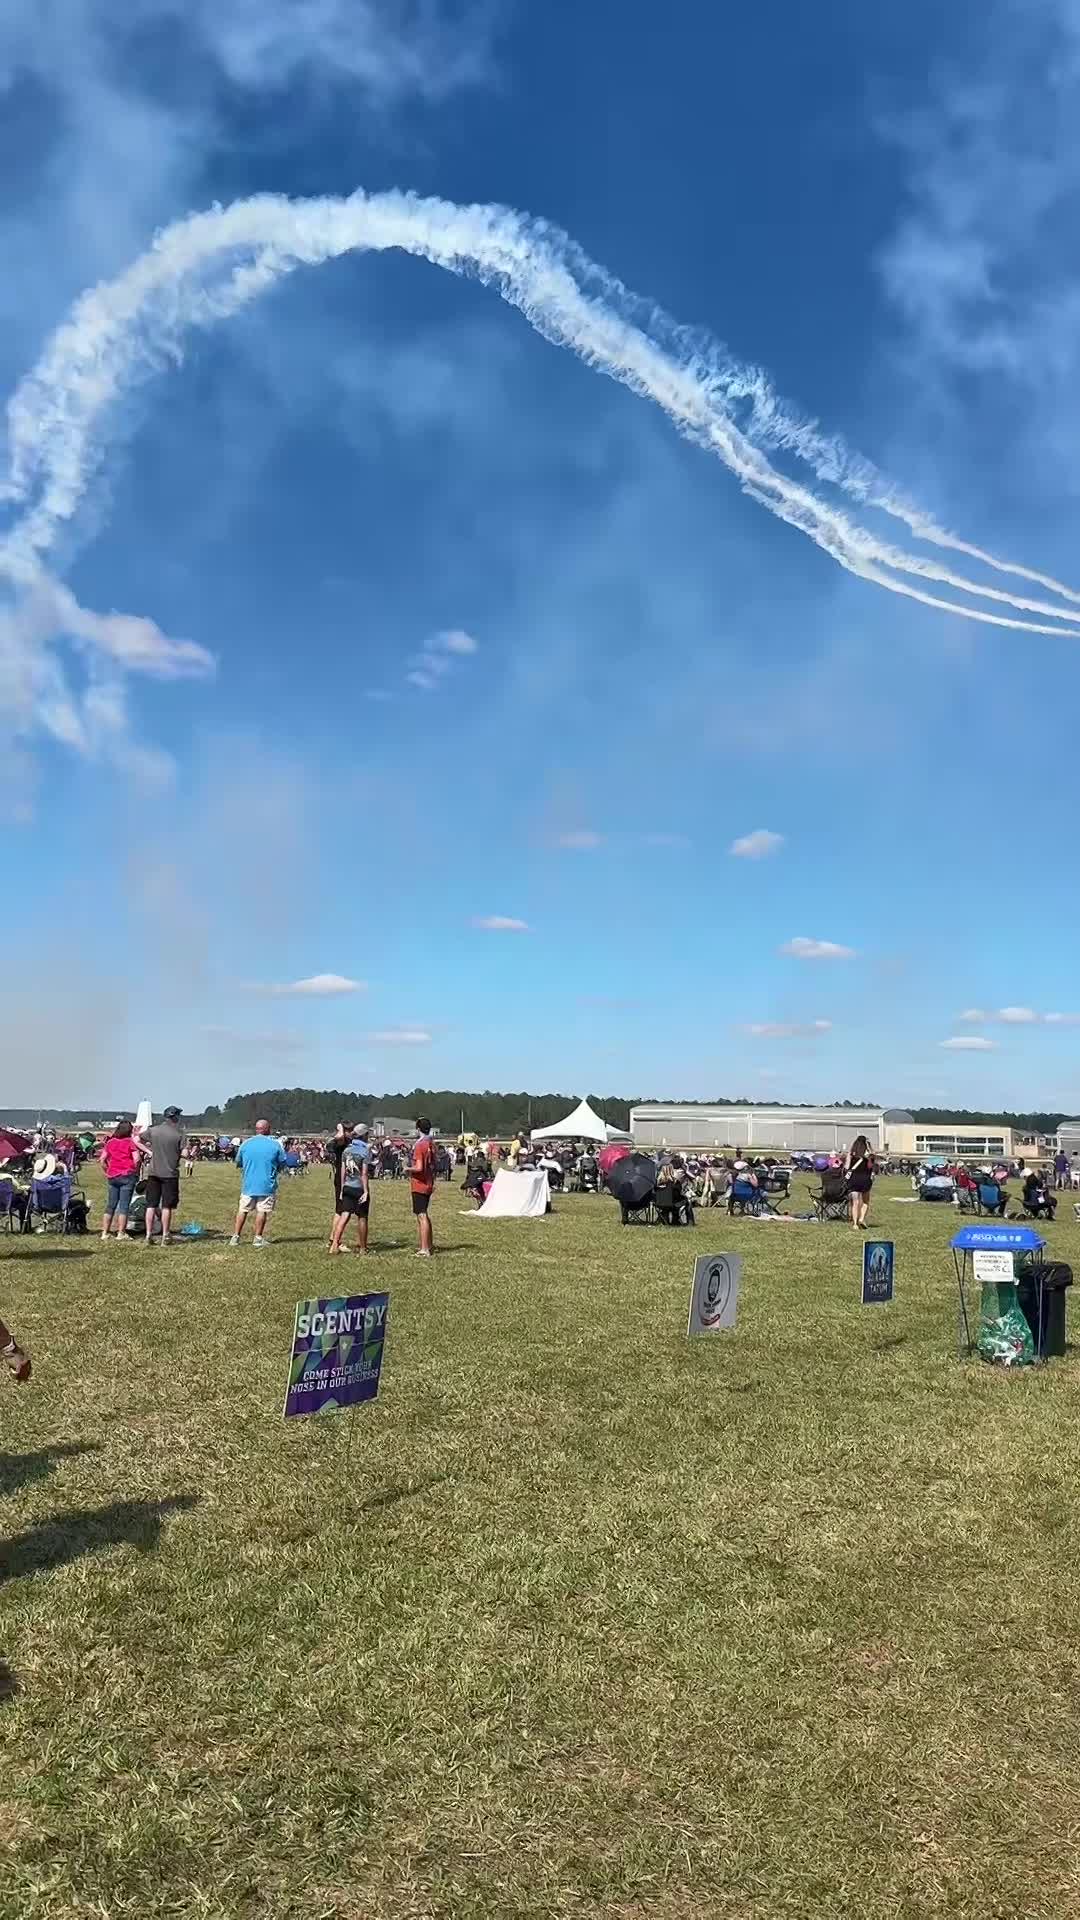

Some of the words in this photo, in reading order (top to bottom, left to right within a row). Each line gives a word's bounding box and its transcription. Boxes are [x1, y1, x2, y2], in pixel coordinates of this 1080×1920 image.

[297, 1305, 386, 1338] SCENTSY
[303, 1369, 329, 1381] COME
[316, 1380, 327, 1390] IN
[329, 1377, 346, 1388] OUR
